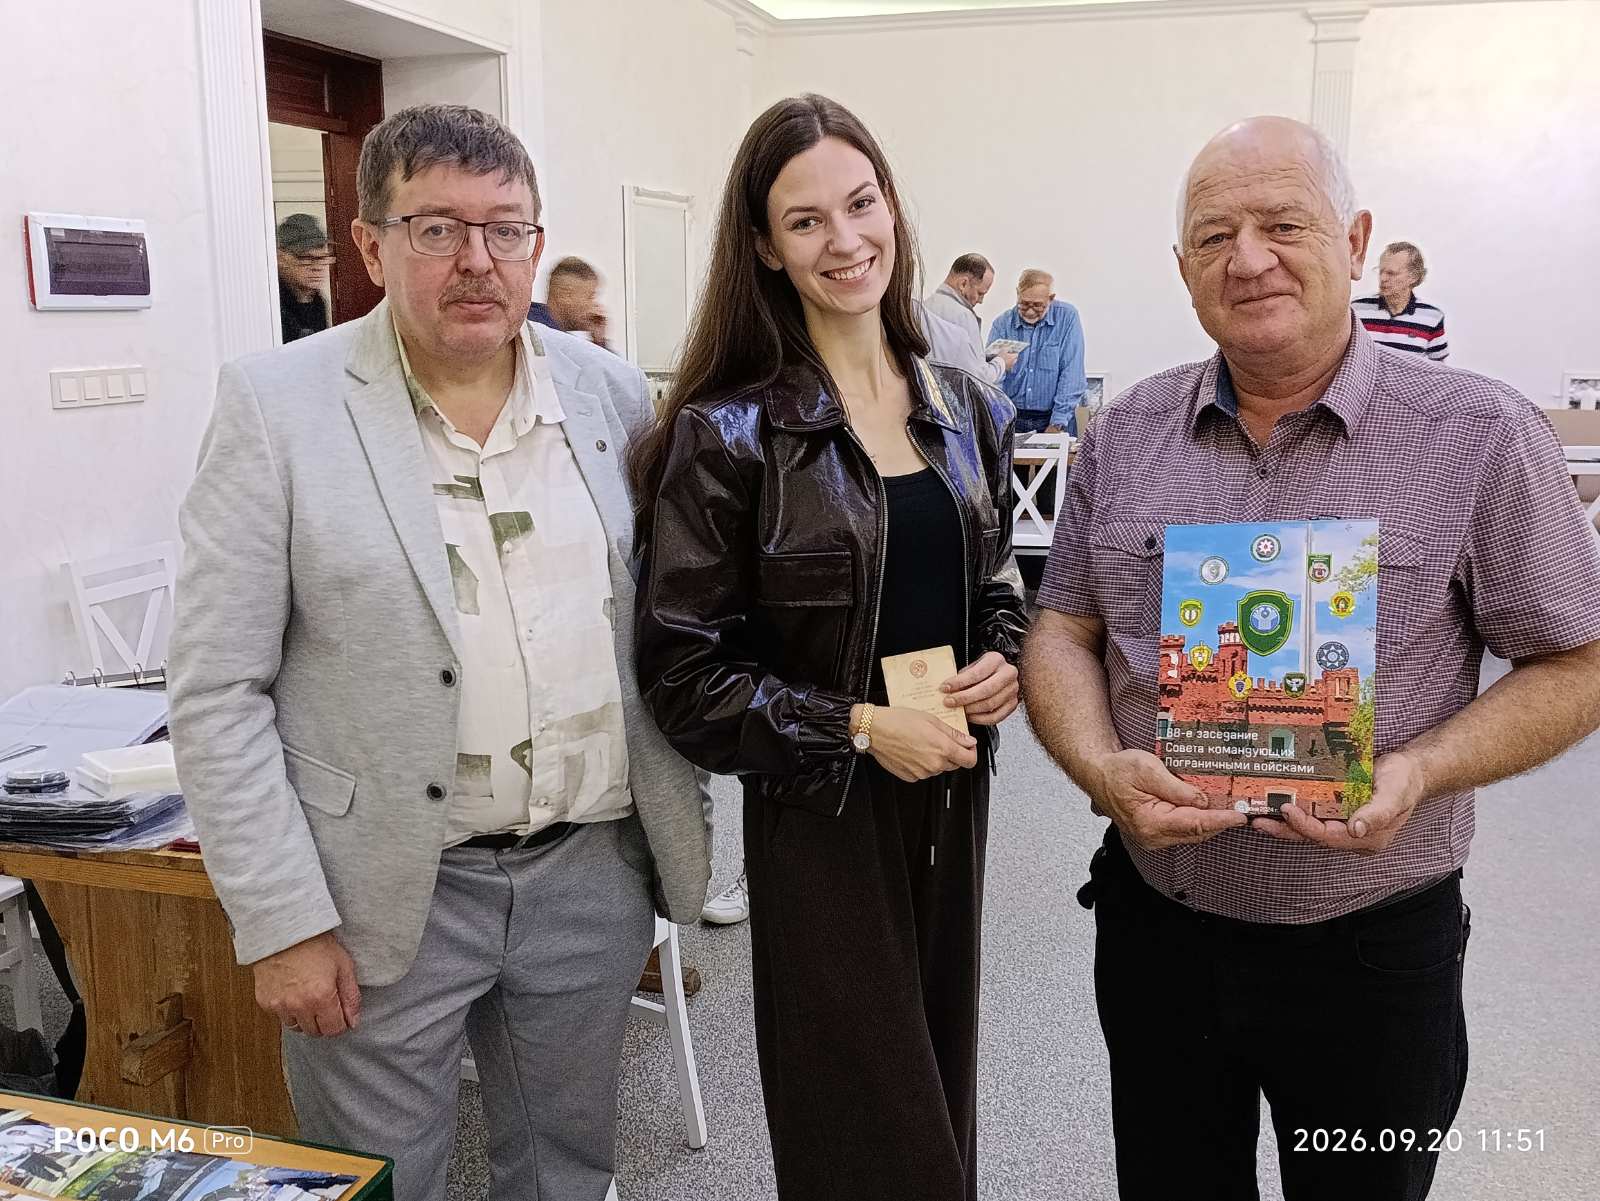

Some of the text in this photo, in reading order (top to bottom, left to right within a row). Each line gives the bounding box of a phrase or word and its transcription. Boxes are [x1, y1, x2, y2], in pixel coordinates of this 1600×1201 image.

[1196, 730, 1258, 742] заседание
[1165, 742, 1295, 757] Совета командующих
[1165, 757, 1315, 774] Пограничными войсками
